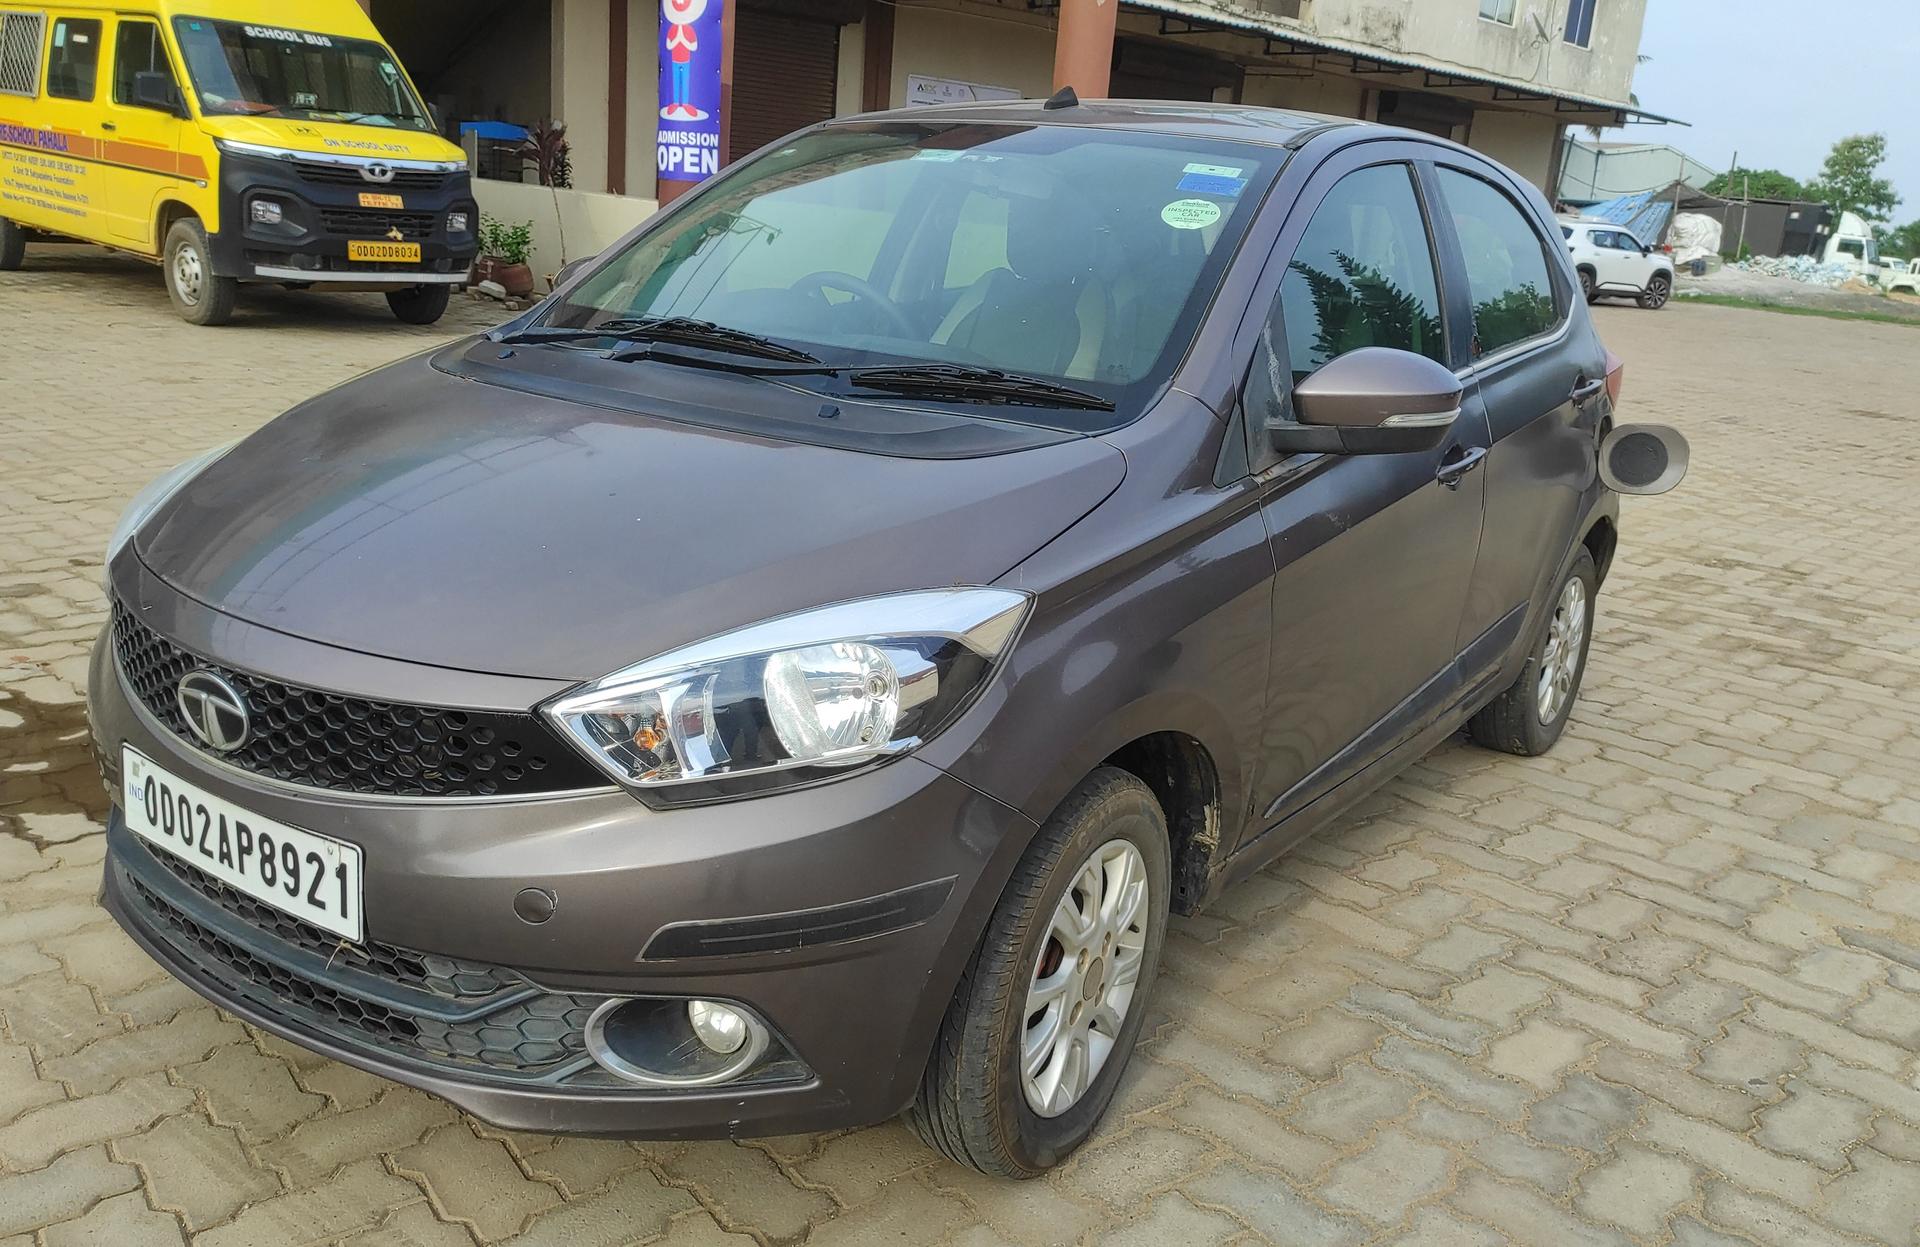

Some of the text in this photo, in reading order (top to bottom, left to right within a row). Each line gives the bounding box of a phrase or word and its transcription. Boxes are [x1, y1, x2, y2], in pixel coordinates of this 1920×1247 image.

[244, 26, 332, 47] SCHOOL BUS
[323, 138, 410, 153] ON SCHOOL DUTY
[657, 130, 719, 147] ADMISSION
[657, 146, 719, 174] OPEN
[1168, 207, 1217, 216] INSPECTED
[128, 774, 348, 919] IND OD02AP8921
